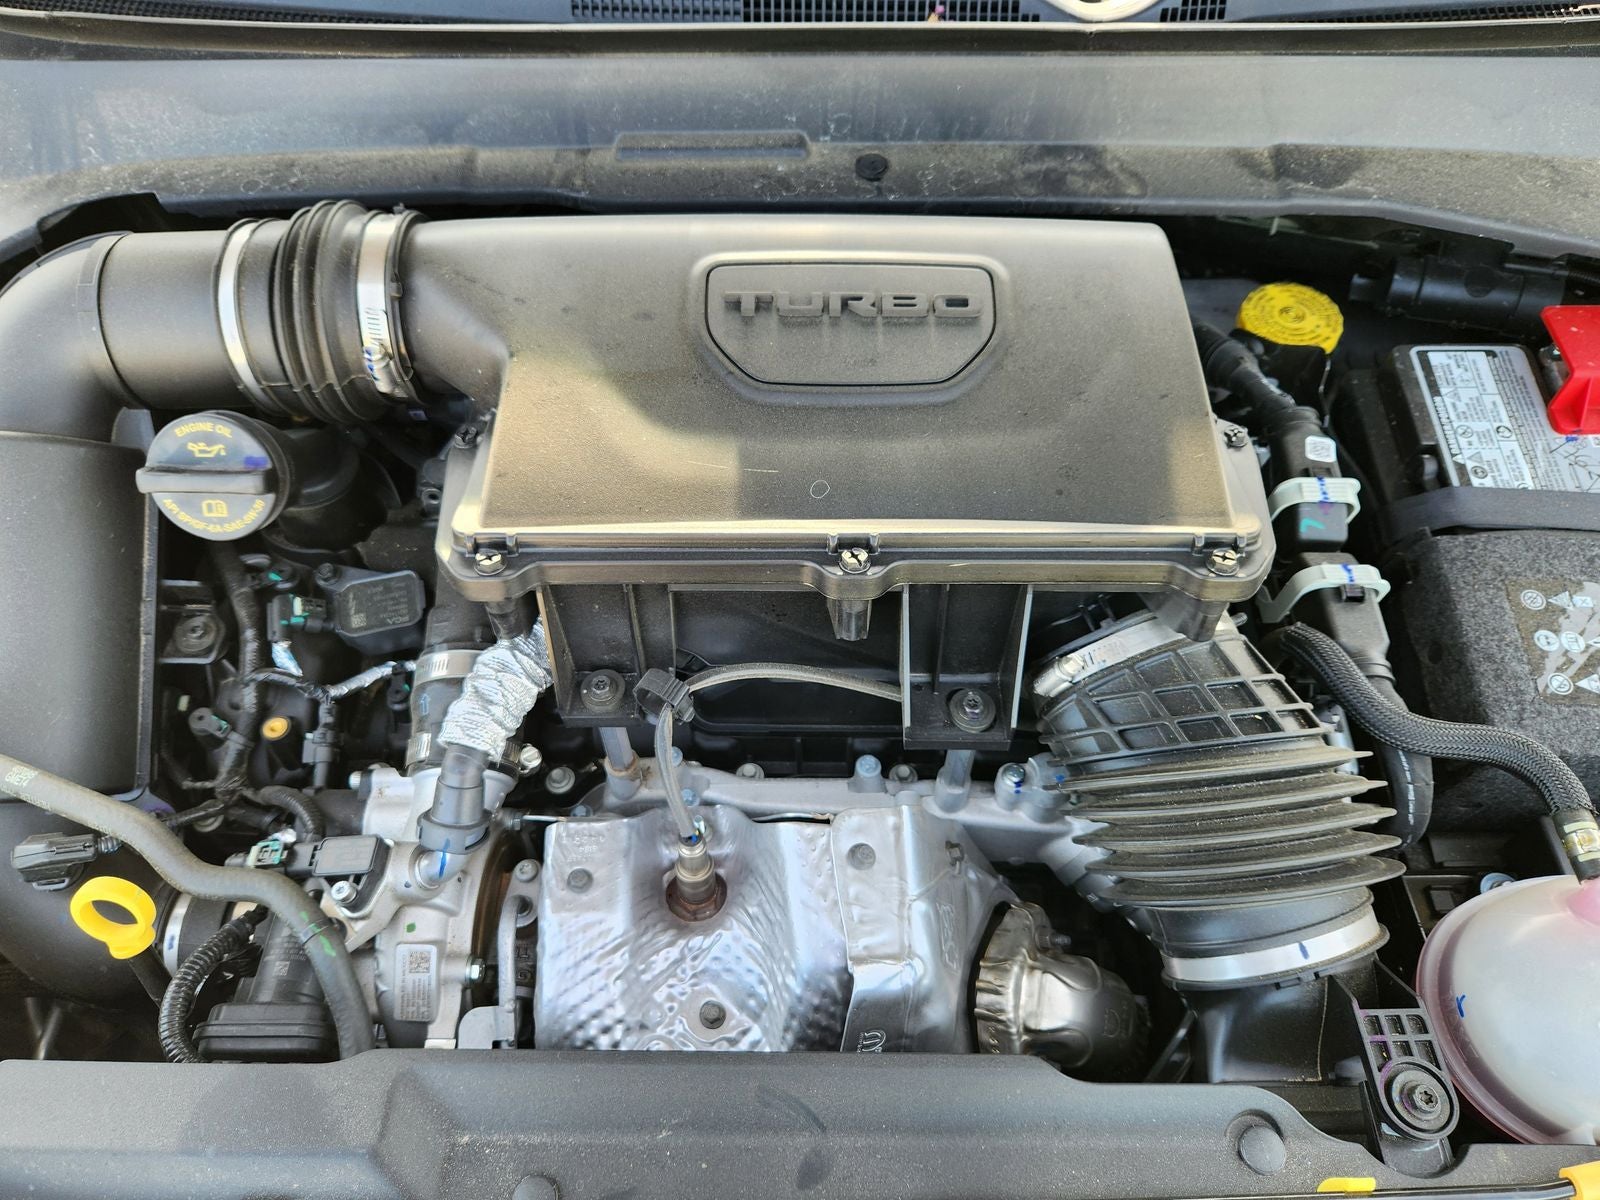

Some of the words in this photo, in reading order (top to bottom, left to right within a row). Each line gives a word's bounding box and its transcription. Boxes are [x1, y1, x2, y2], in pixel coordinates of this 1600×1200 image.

[723, 291, 984, 318] TURBO
[174, 420, 215, 438] ENGINE
[214, 423, 233, 438] OIL
